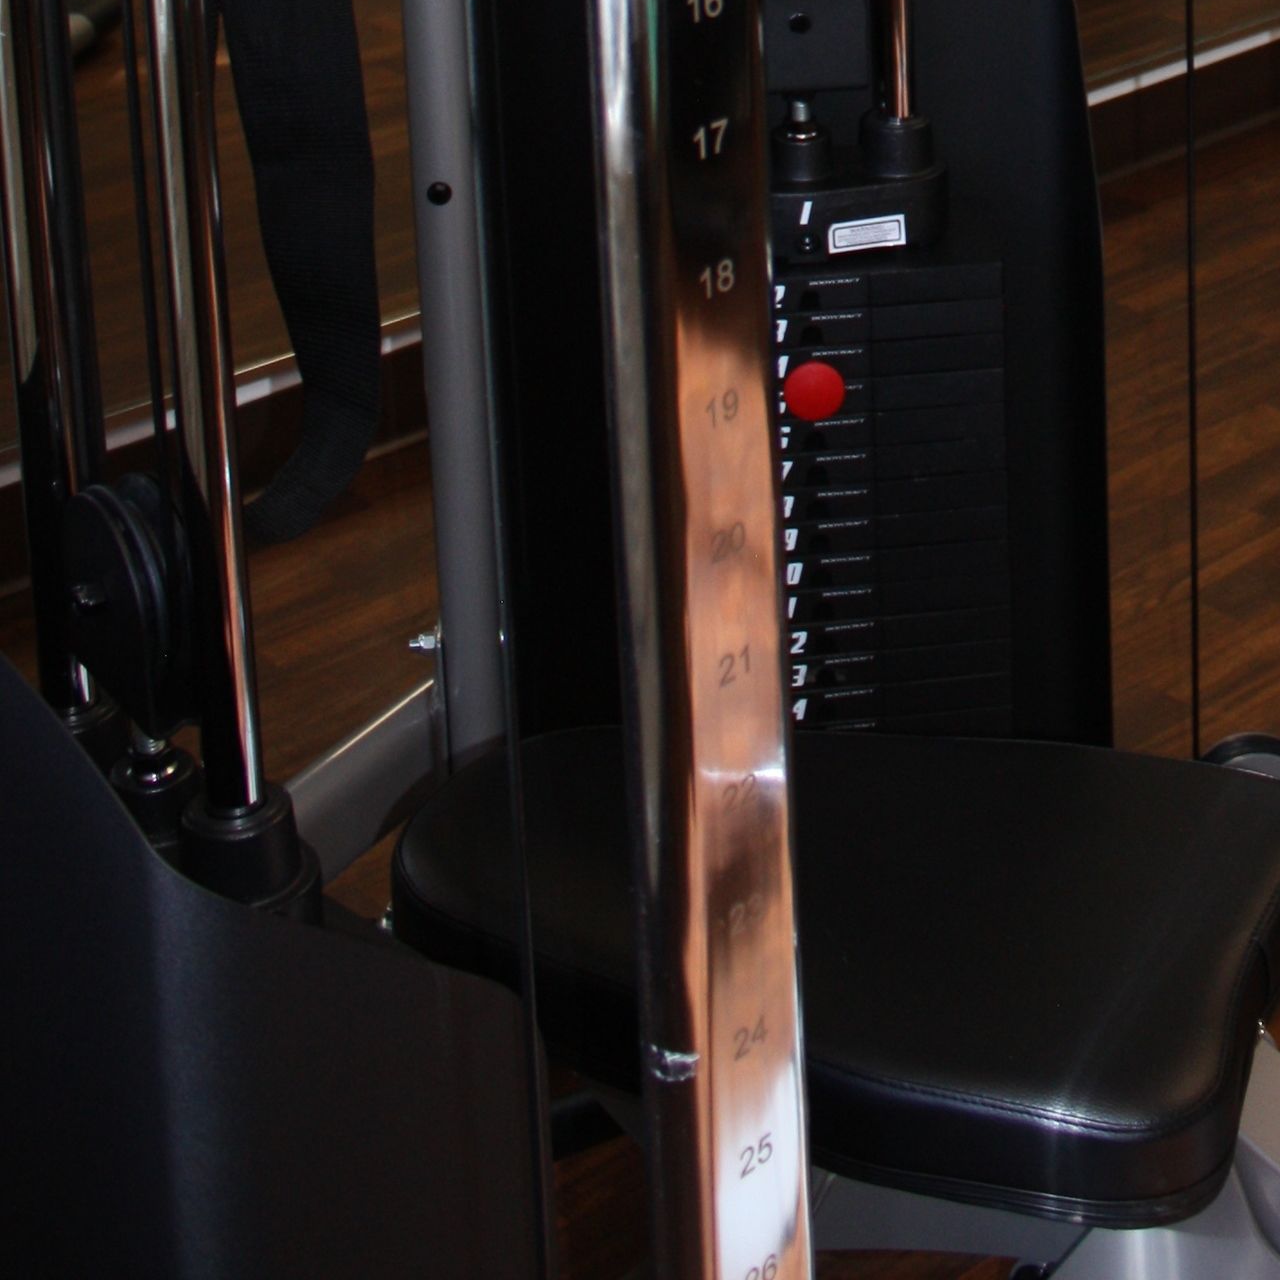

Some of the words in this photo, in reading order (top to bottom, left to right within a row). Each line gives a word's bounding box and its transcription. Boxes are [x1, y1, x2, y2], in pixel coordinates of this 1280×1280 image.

[693, 117, 728, 160] 17
[800, 200, 813, 226] 1
[700, 258, 735, 300] 18
[705, 386, 739, 429] 19
[711, 521, 746, 565] 20
[786, 562, 804, 586] 0
[790, 630, 808, 655] 2
[718, 645, 752, 689] 21
[791, 664, 808, 687] 3
[792, 698, 808, 721] 4
[722, 774, 757, 816] 22
[734, 1012, 768, 1062] 24
[739, 1132, 773, 1180] 25
